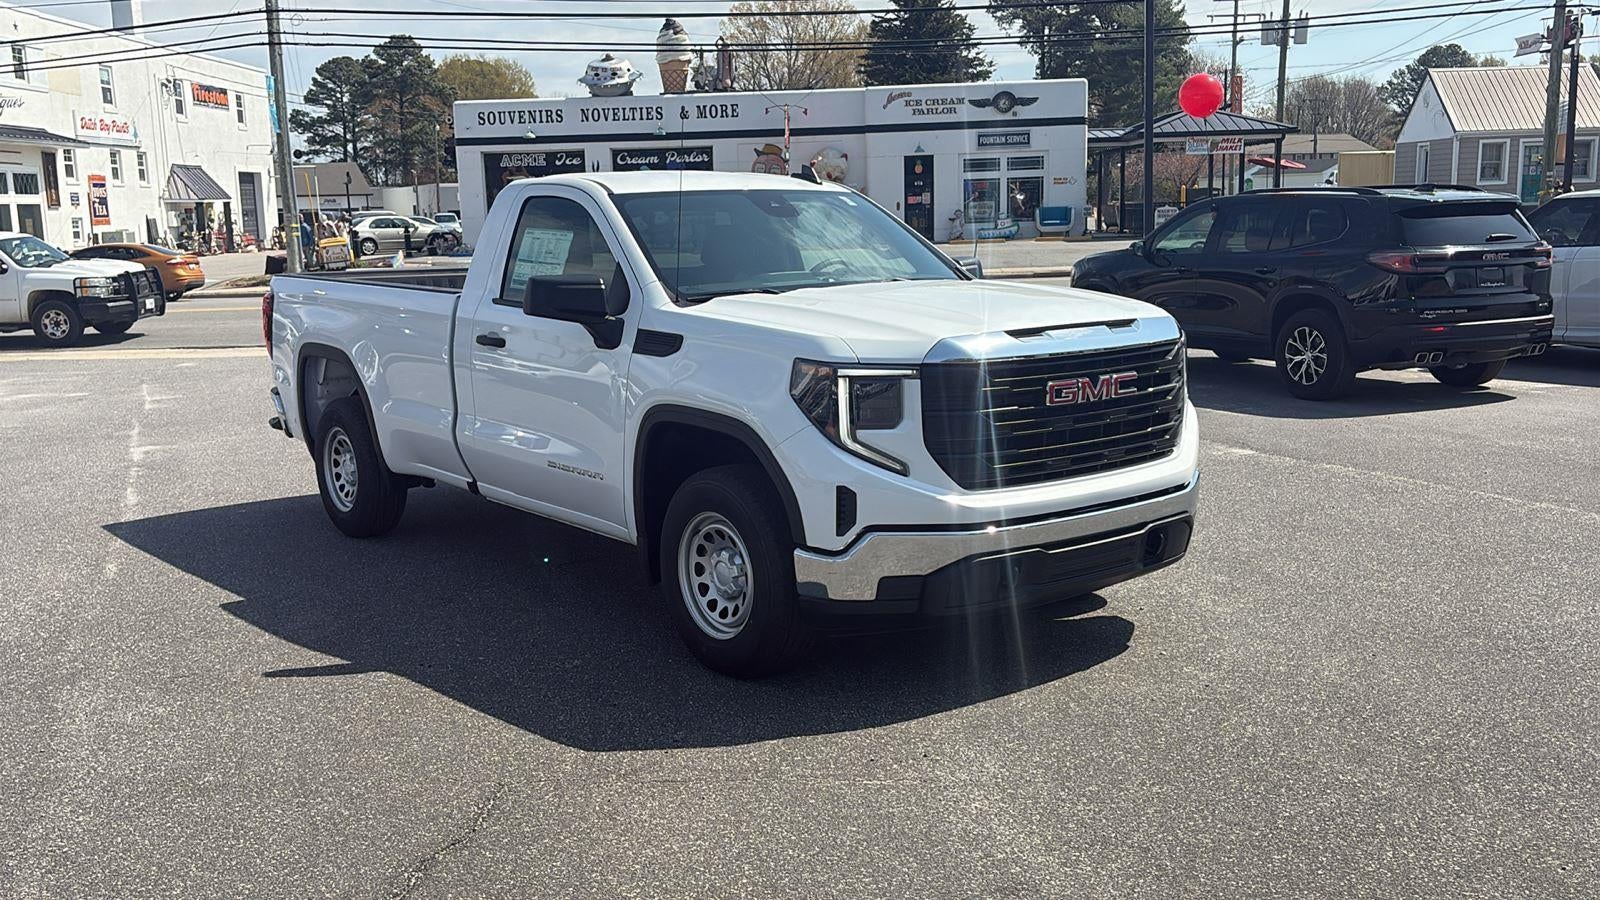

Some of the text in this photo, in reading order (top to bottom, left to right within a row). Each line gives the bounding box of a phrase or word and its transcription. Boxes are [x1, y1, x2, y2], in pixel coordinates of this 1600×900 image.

[904, 97, 966, 107] ICE CREAM
[477, 103, 740, 126] SOUVENIRS NOVELTIES & MORE
[912, 106, 957, 116] PARLOR
[80, 116, 98, 131] Dutch
[99, 118, 111, 136] Boy
[979, 134, 1029, 145] FOUNTAIN SERVICE
[500, 153, 582, 167] ACME Ice
[616, 151, 710, 165] Cream Parlor
[93, 202, 108, 216] TEA
[1045, 371, 1139, 406] GMC
[547, 460, 605, 481] SIERRA
